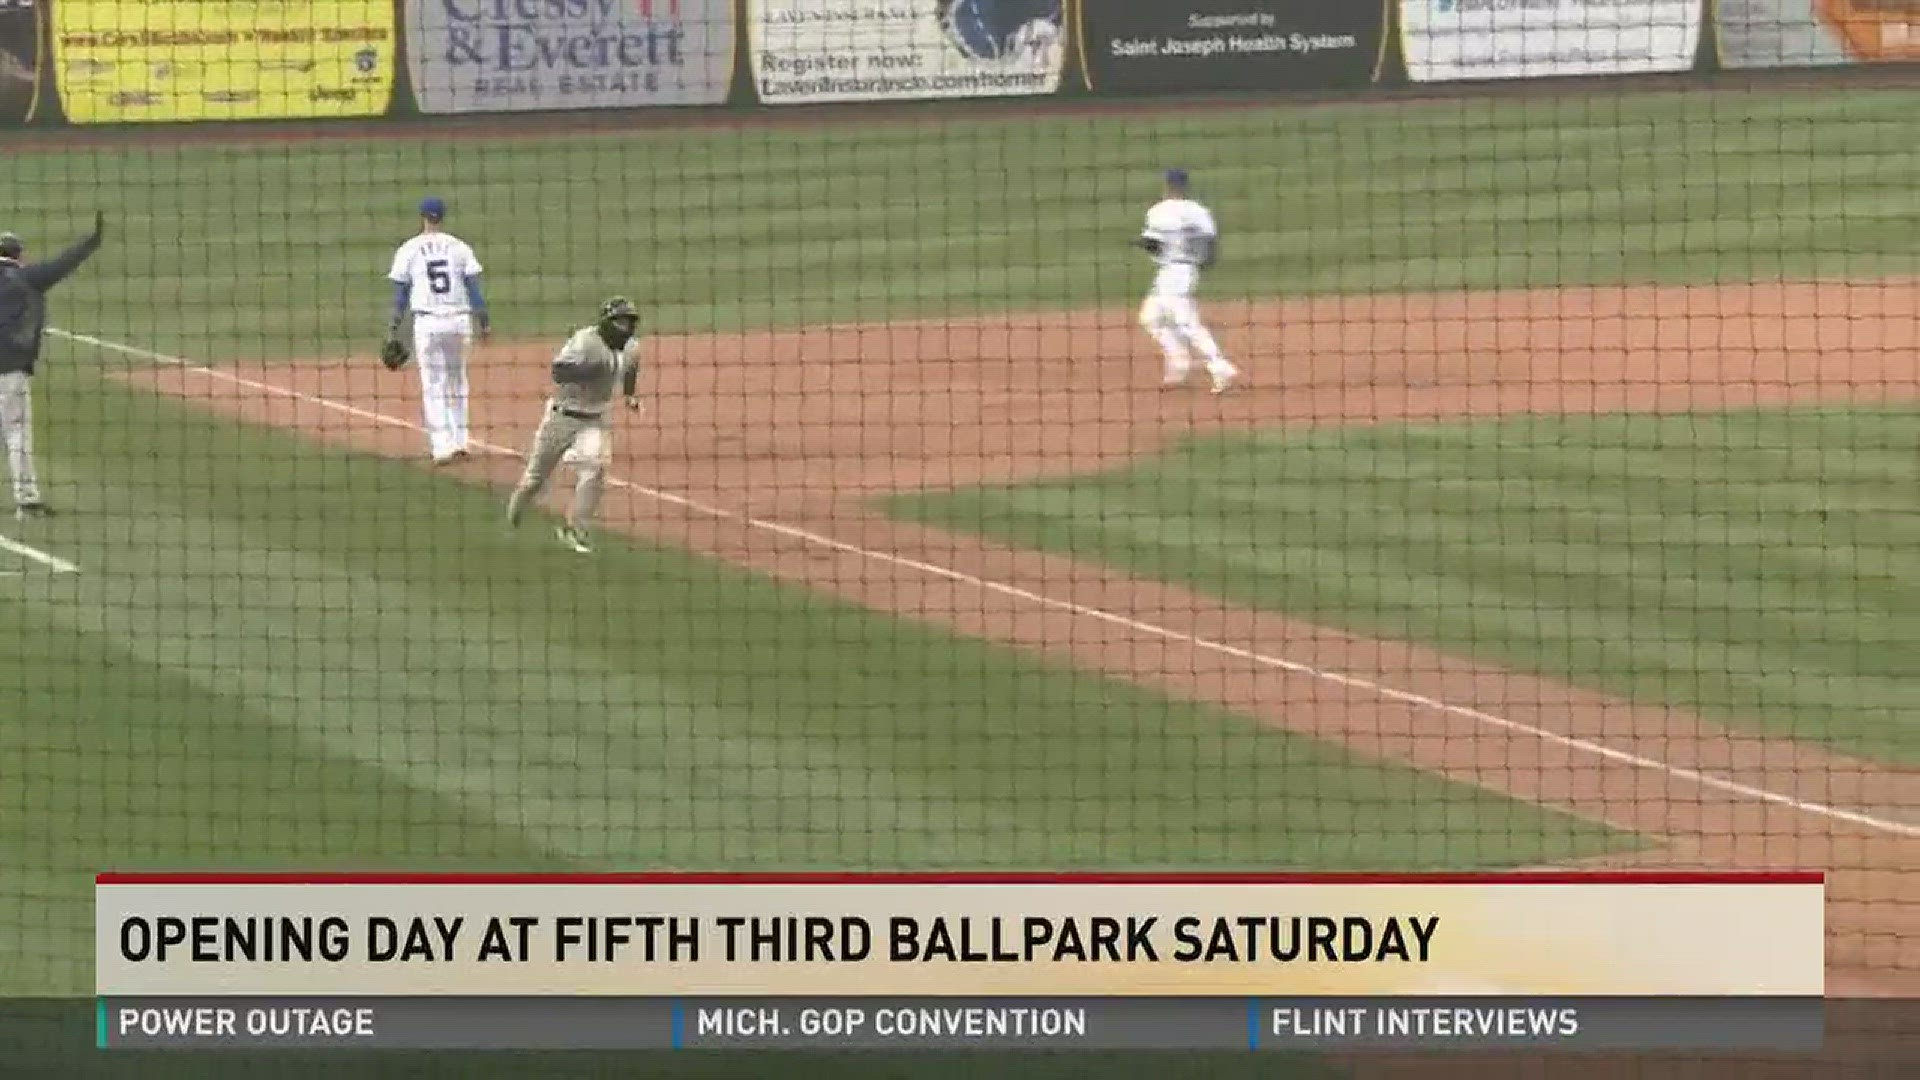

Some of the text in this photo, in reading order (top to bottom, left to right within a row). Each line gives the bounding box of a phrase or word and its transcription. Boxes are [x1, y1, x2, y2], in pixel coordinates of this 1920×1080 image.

[446, 22, 684, 71] & Everett
[1111, 32, 1356, 58] Saint Joseph Health System
[761, 52, 922, 75] Register now:
[475, 72, 660, 97] REAL ESTATE
[427, 259, 451, 294] 5
